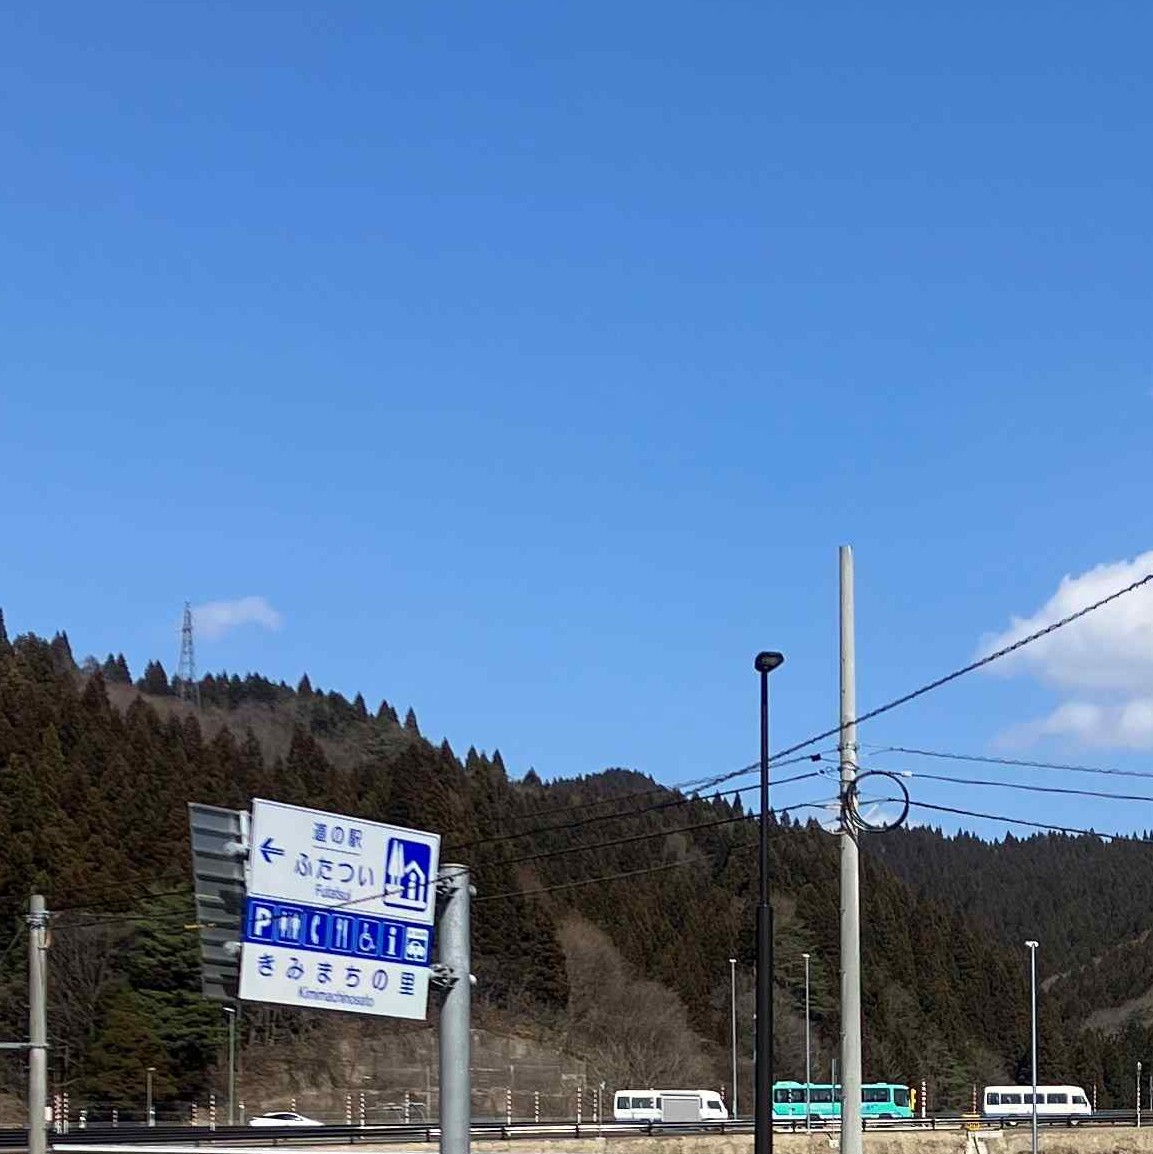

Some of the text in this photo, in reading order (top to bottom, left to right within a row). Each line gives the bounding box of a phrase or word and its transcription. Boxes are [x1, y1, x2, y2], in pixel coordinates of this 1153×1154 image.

[313, 822, 362, 849] 道の駅
[295, 852, 374, 887] ふたつい
[255, 907, 272, 936] P
[257, 952, 416, 996] きみまちの里
